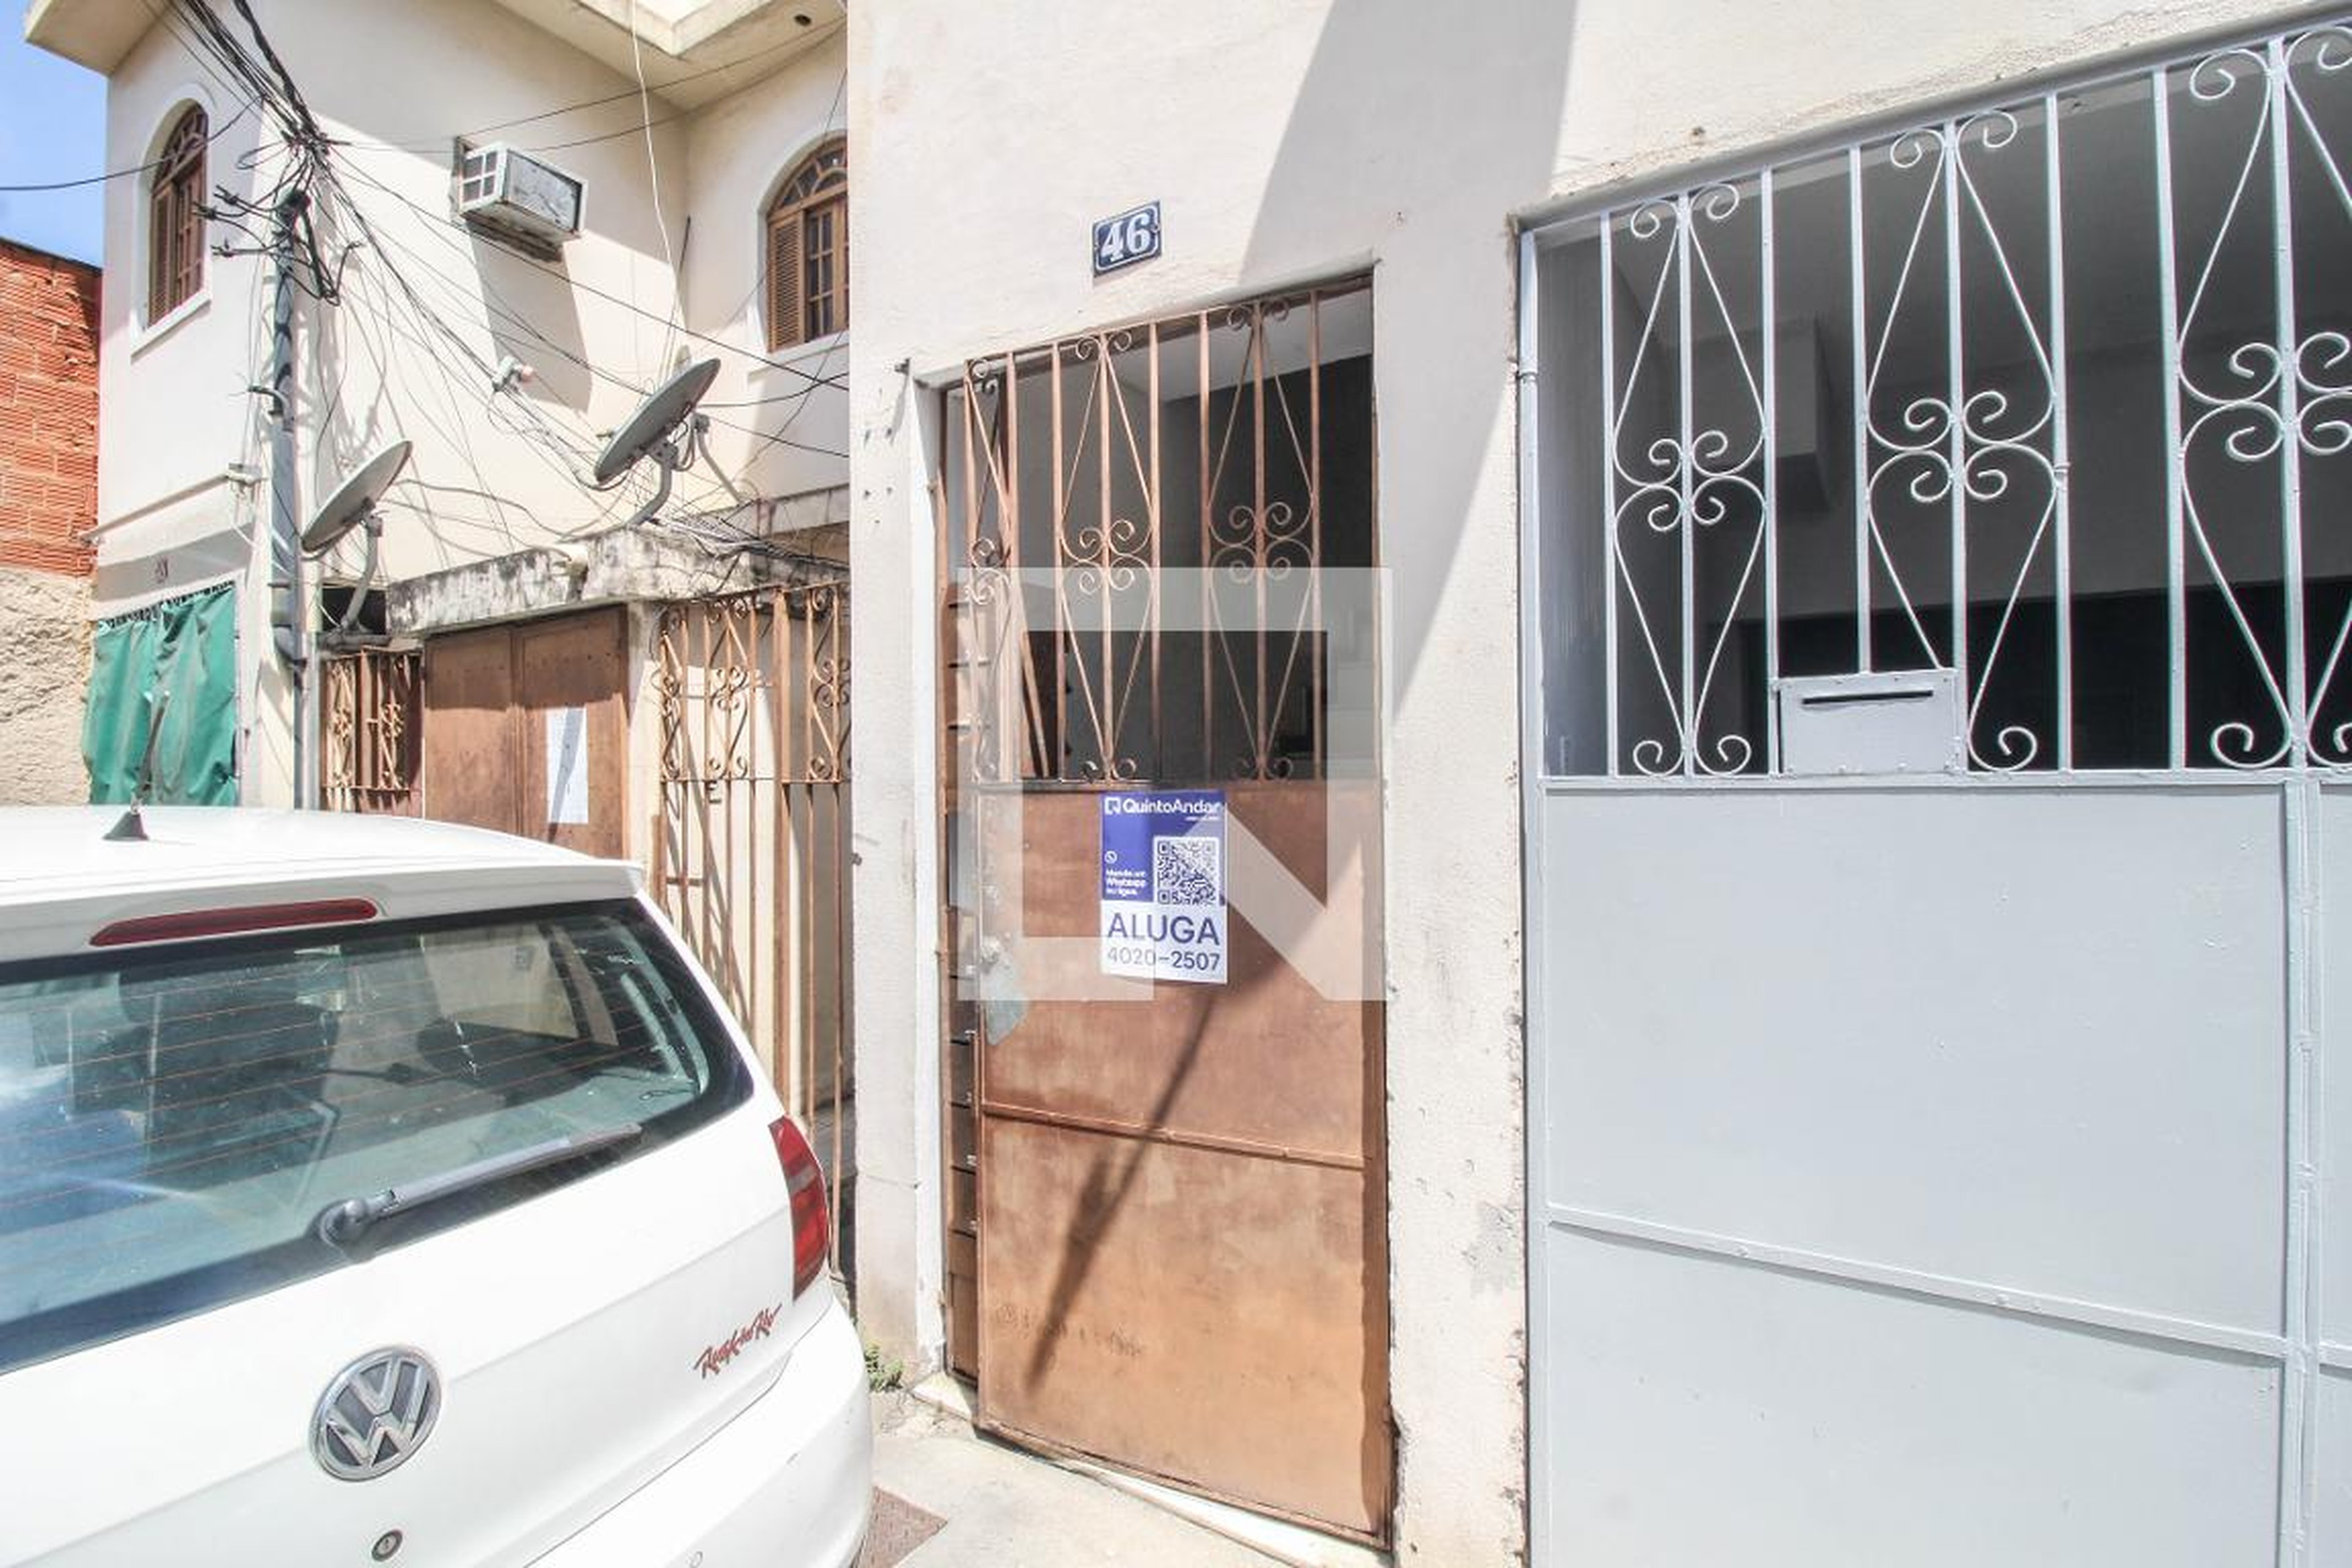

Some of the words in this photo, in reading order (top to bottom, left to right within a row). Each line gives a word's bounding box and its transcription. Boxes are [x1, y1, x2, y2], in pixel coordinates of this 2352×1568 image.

[1101, 212, 1151, 262] 46
[1123, 797, 1223, 814] QuintoAndar
[1107, 912, 1221, 946] ALUGA
[1107, 947, 1221, 971] 4020-2507
